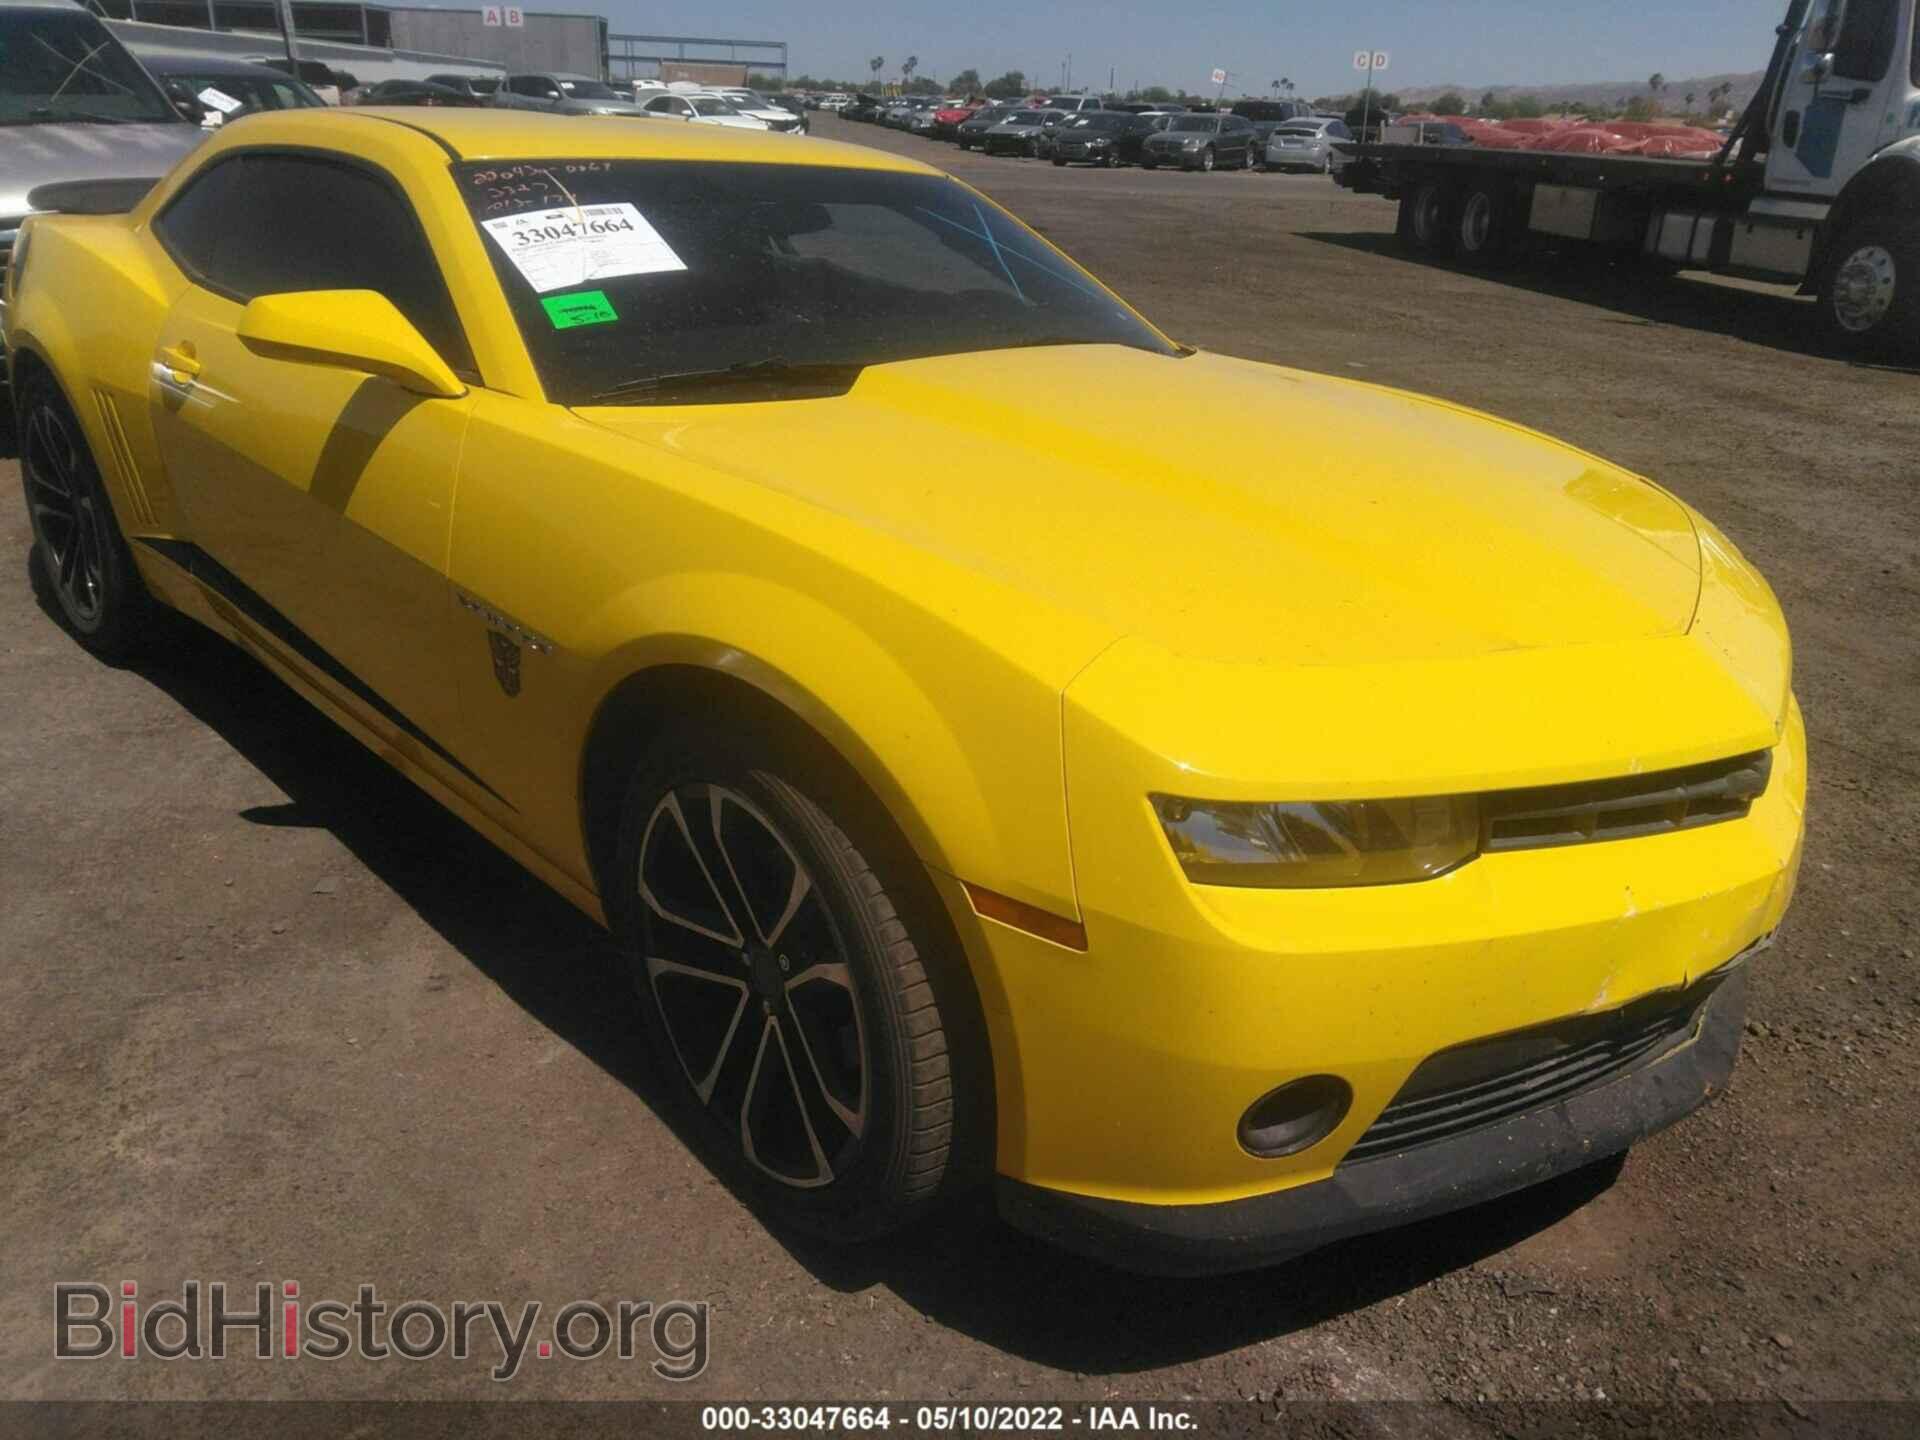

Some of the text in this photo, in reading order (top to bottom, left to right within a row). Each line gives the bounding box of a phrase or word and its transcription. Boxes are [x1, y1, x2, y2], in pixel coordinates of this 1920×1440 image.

[487, 9, 520, 24] A B
[1356, 54, 1386, 67] C D
[512, 217, 635, 247] 33047664
